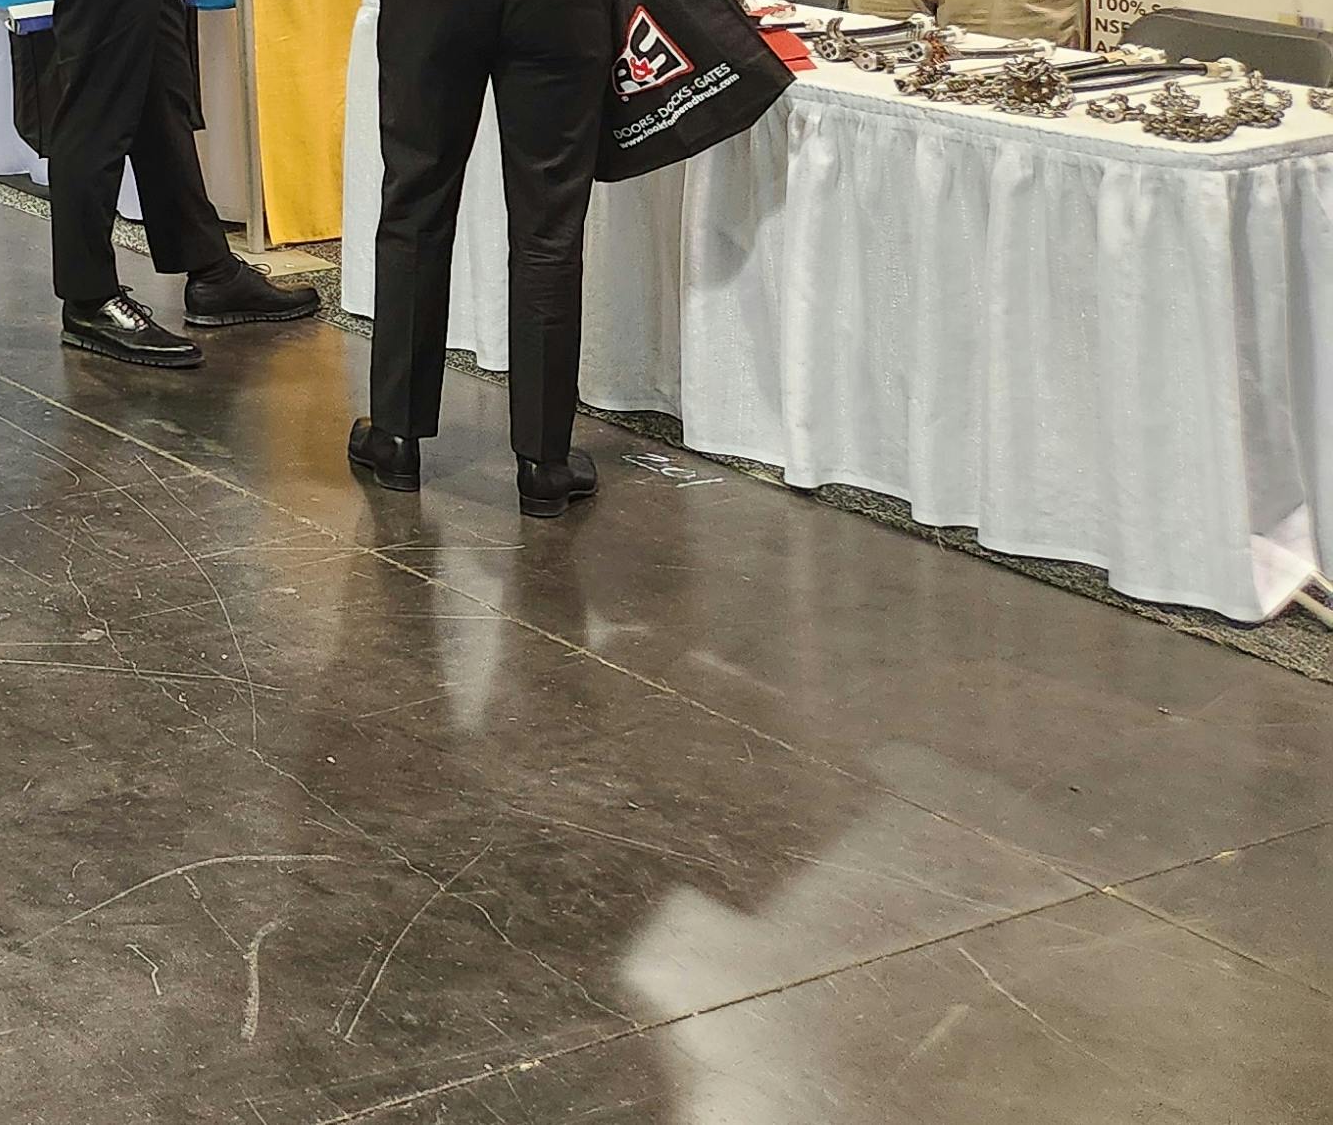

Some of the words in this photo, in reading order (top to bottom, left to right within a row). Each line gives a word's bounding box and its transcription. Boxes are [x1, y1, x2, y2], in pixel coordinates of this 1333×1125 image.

[613, 114, 655, 140] DOORS
[657, 86, 692, 118] DOCKS
[693, 62, 732, 89] GATES
[619, 73, 740, 149] www.lookfortheredtruck.com
